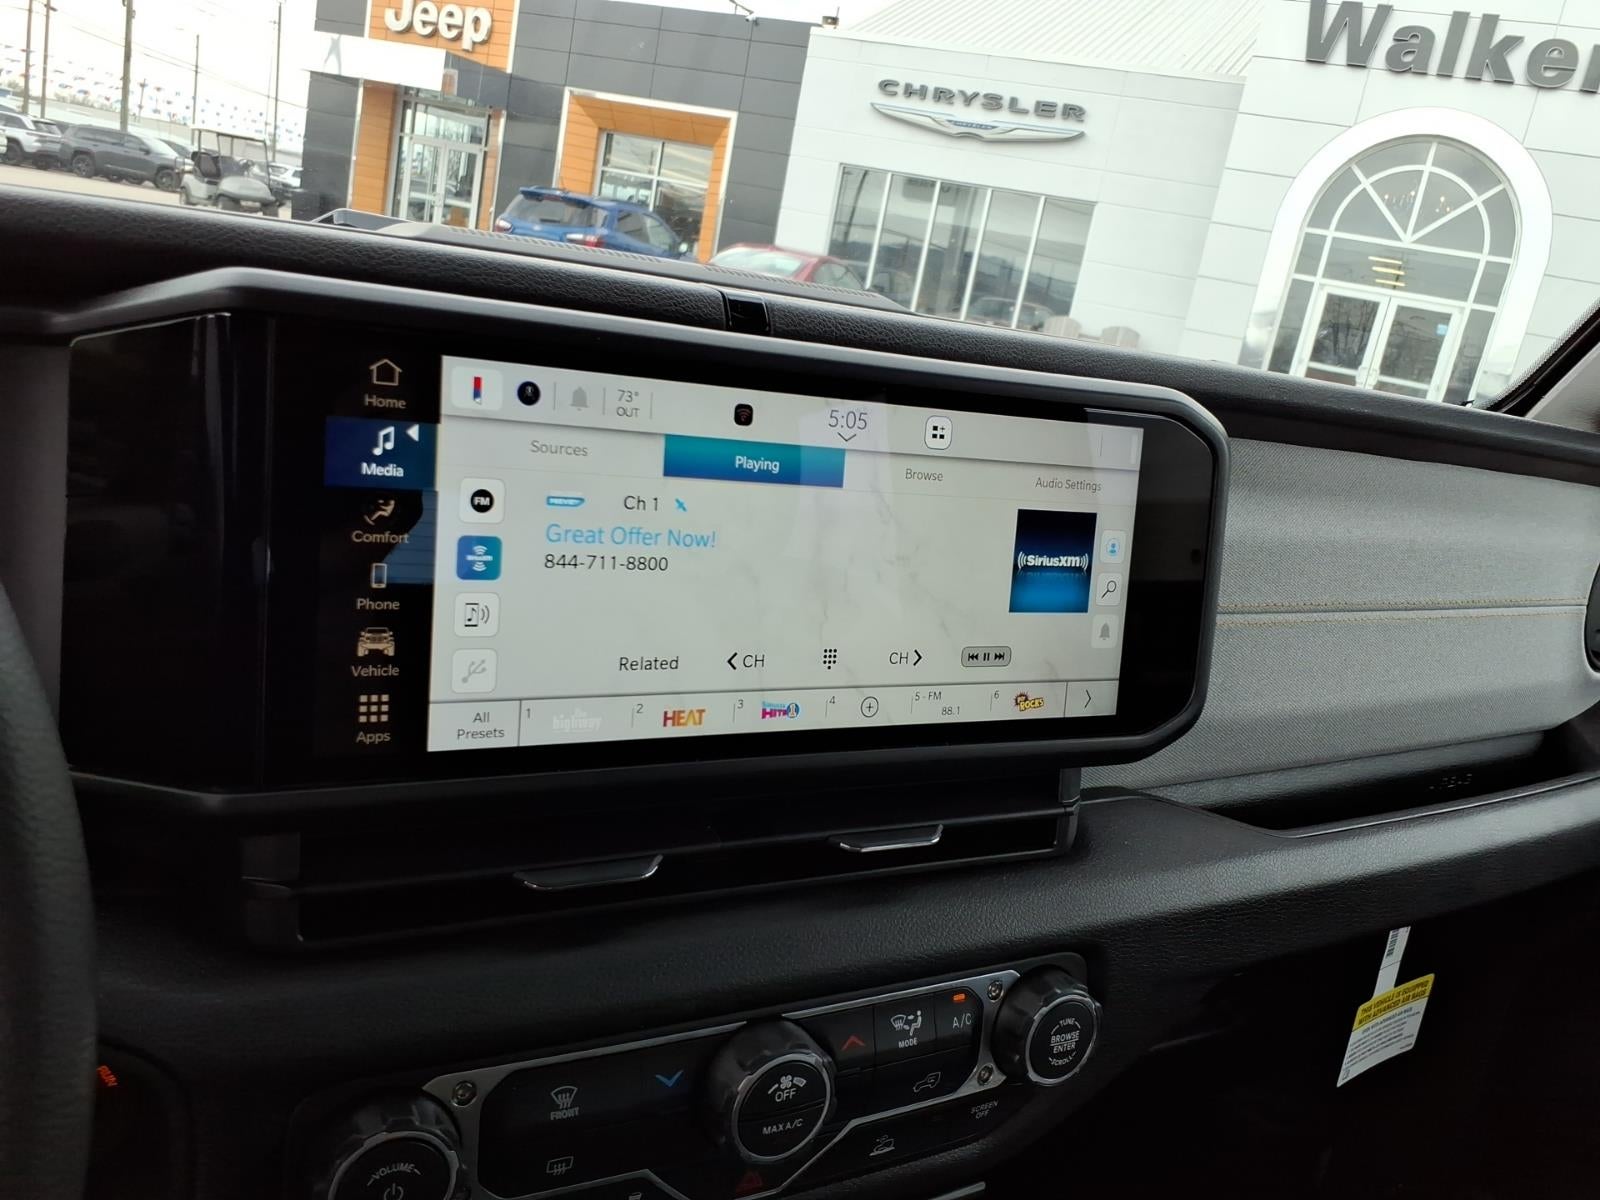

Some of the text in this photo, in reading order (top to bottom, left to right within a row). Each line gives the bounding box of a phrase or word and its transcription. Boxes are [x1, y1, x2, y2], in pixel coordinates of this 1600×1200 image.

[384, 0, 492, 51] Jeep
[877, 79, 1087, 122] CHRYSLER
[364, 394, 407, 409] Home
[616, 406, 640, 419] OUT
[828, 409, 868, 431] 5:05
[530, 440, 588, 457] Sources
[361, 462, 404, 478] Media
[735, 455, 780, 474] Playing
[905, 468, 944, 483] Browse
[1035, 477, 1102, 494] Audio Settings
[474, 496, 490, 506] FM
[623, 495, 660, 511] Ch 1
[352, 530, 409, 545] Comfort
[545, 524, 716, 548] Great Offer Now!
[544, 554, 669, 571] 844-711-8800
[356, 598, 400, 611] Phone
[618, 656, 679, 671] Related
[742, 654, 765, 668] CH
[889, 651, 909, 665] CH
[352, 665, 400, 677] Vehicle
[829, 695, 836, 705] 4
[914, 692, 921, 701] 5
[928, 691, 942, 701] FM
[993, 690, 1000, 700] 6
[635, 704, 644, 714] 2
[737, 700, 744, 710] 3
[941, 706, 961, 717] 88.1
[472, 711, 490, 724] All
[526, 708, 531, 719] 1
[662, 709, 706, 727] HEAT
[356, 731, 391, 745] Apps
[456, 727, 505, 741] Presets
[952, 1013, 972, 1029] A/C
[1059, 1017, 1076, 1027] TUNE
[898, 1037, 918, 1049] MODE
[1051, 1030, 1080, 1044] BROWSE
[1053, 1041, 1076, 1054] ENTER
[775, 1087, 798, 1102] OFF
[550, 1106, 580, 1121] FRONT
[970, 1099, 999, 1114] SCREEN
[975, 1109, 990, 1120] OFF
[762, 1118, 804, 1135] MAX A/C
[371, 1162, 416, 1180] VOLUME
